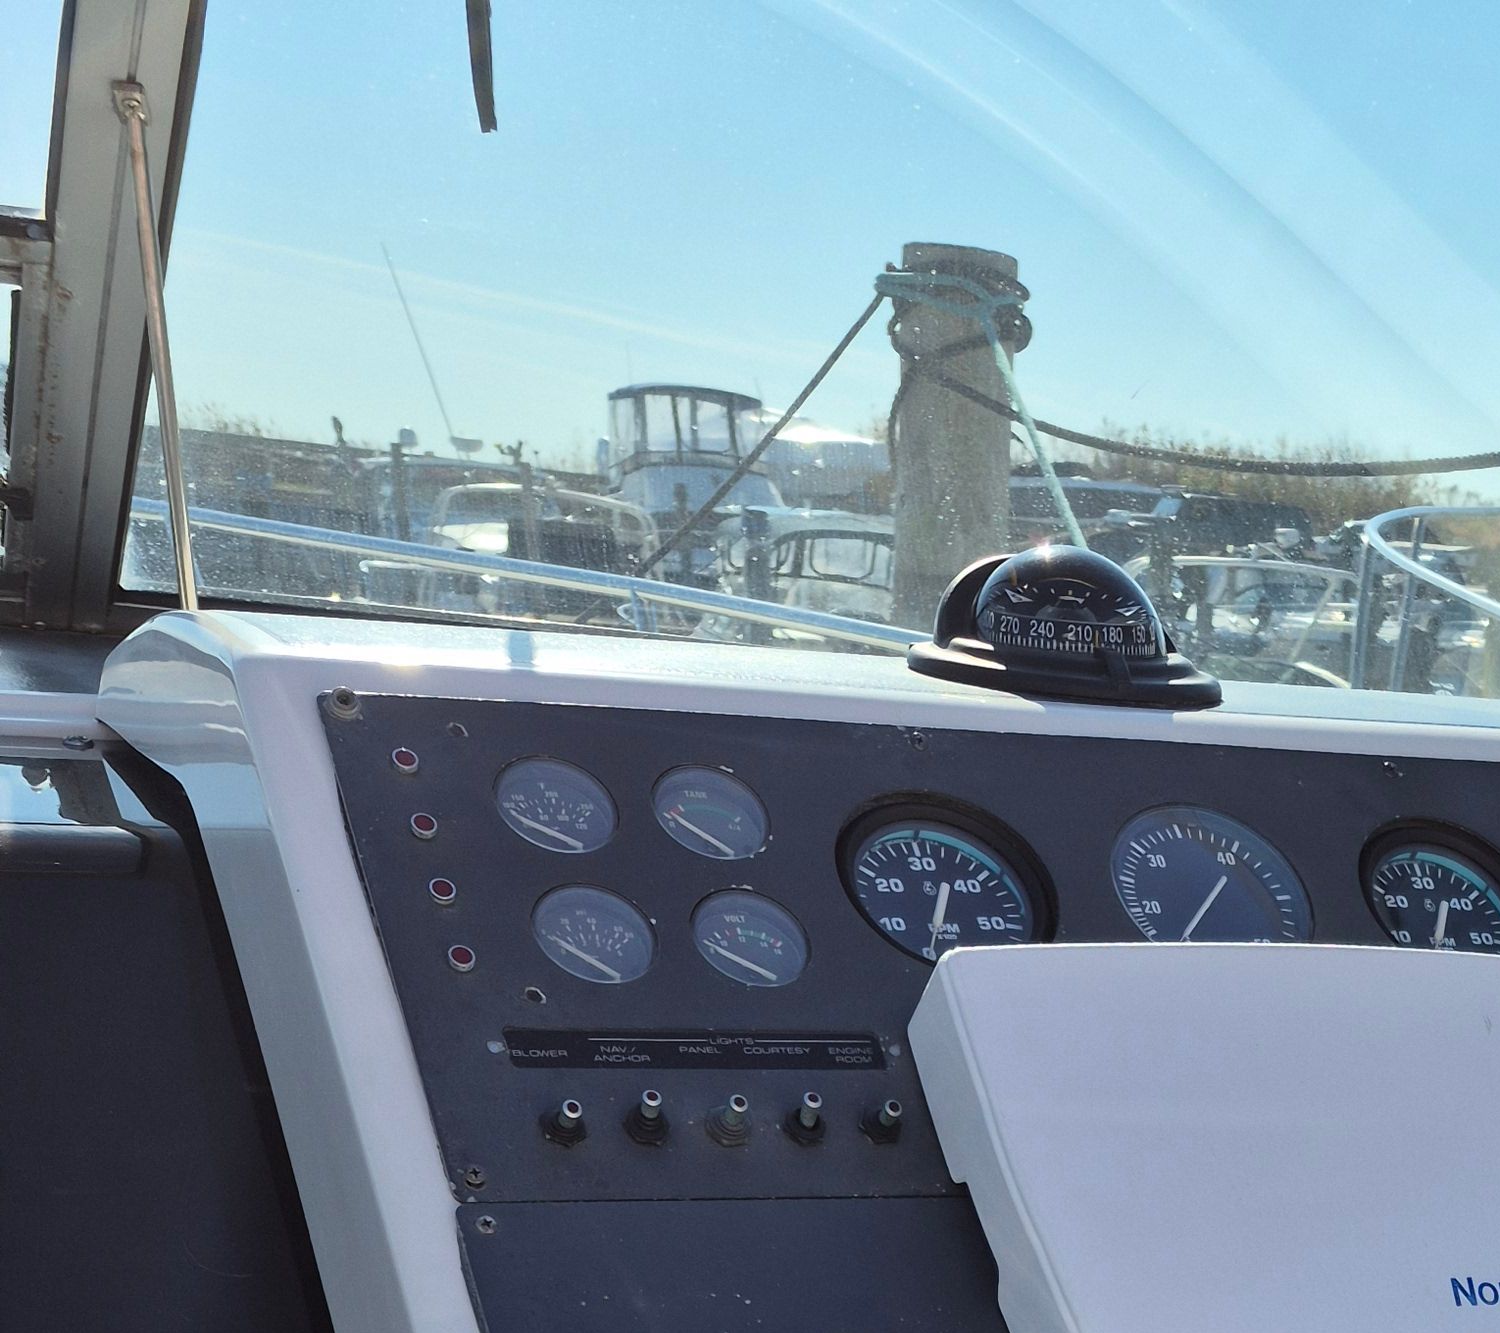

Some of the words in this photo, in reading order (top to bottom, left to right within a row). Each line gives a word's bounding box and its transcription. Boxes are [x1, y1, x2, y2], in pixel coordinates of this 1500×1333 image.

[1000, 615, 1020, 634] 270
[1030, 620, 1054, 638] 240
[1068, 624, 1092, 642] 210
[1102, 626, 1122, 643] 180
[1132, 625, 1146, 643] 150
[908, 857, 936, 872] 30
[1146, 854, 1166, 868] 30
[1216, 851, 1236, 866] 40
[874, 878, 904, 893] 20
[954, 879, 982, 894] 40
[1410, 876, 1435, 890] 30
[1142, 900, 1162, 915] 20
[1384, 895, 1408, 908] 20
[1450, 898, 1474, 912] 40
[724, 914, 745, 922] VOLT
[880, 917, 906, 932] 10
[976, 916, 1006, 930] 50
[927, 922, 960, 934] RPM
[1390, 930, 1412, 944] 10
[1468, 932, 1494, 946] 50
[709, 1038, 754, 1046] LIGHTS
[512, 1050, 568, 1058] BLOWER
[678, 1046, 722, 1054] PANEL
[743, 1046, 812, 1055] COURTESY
[828, 1047, 874, 1056] ENGINE
[593, 1054, 650, 1062] ANCHOR
[835, 1055, 872, 1063] ROOM
